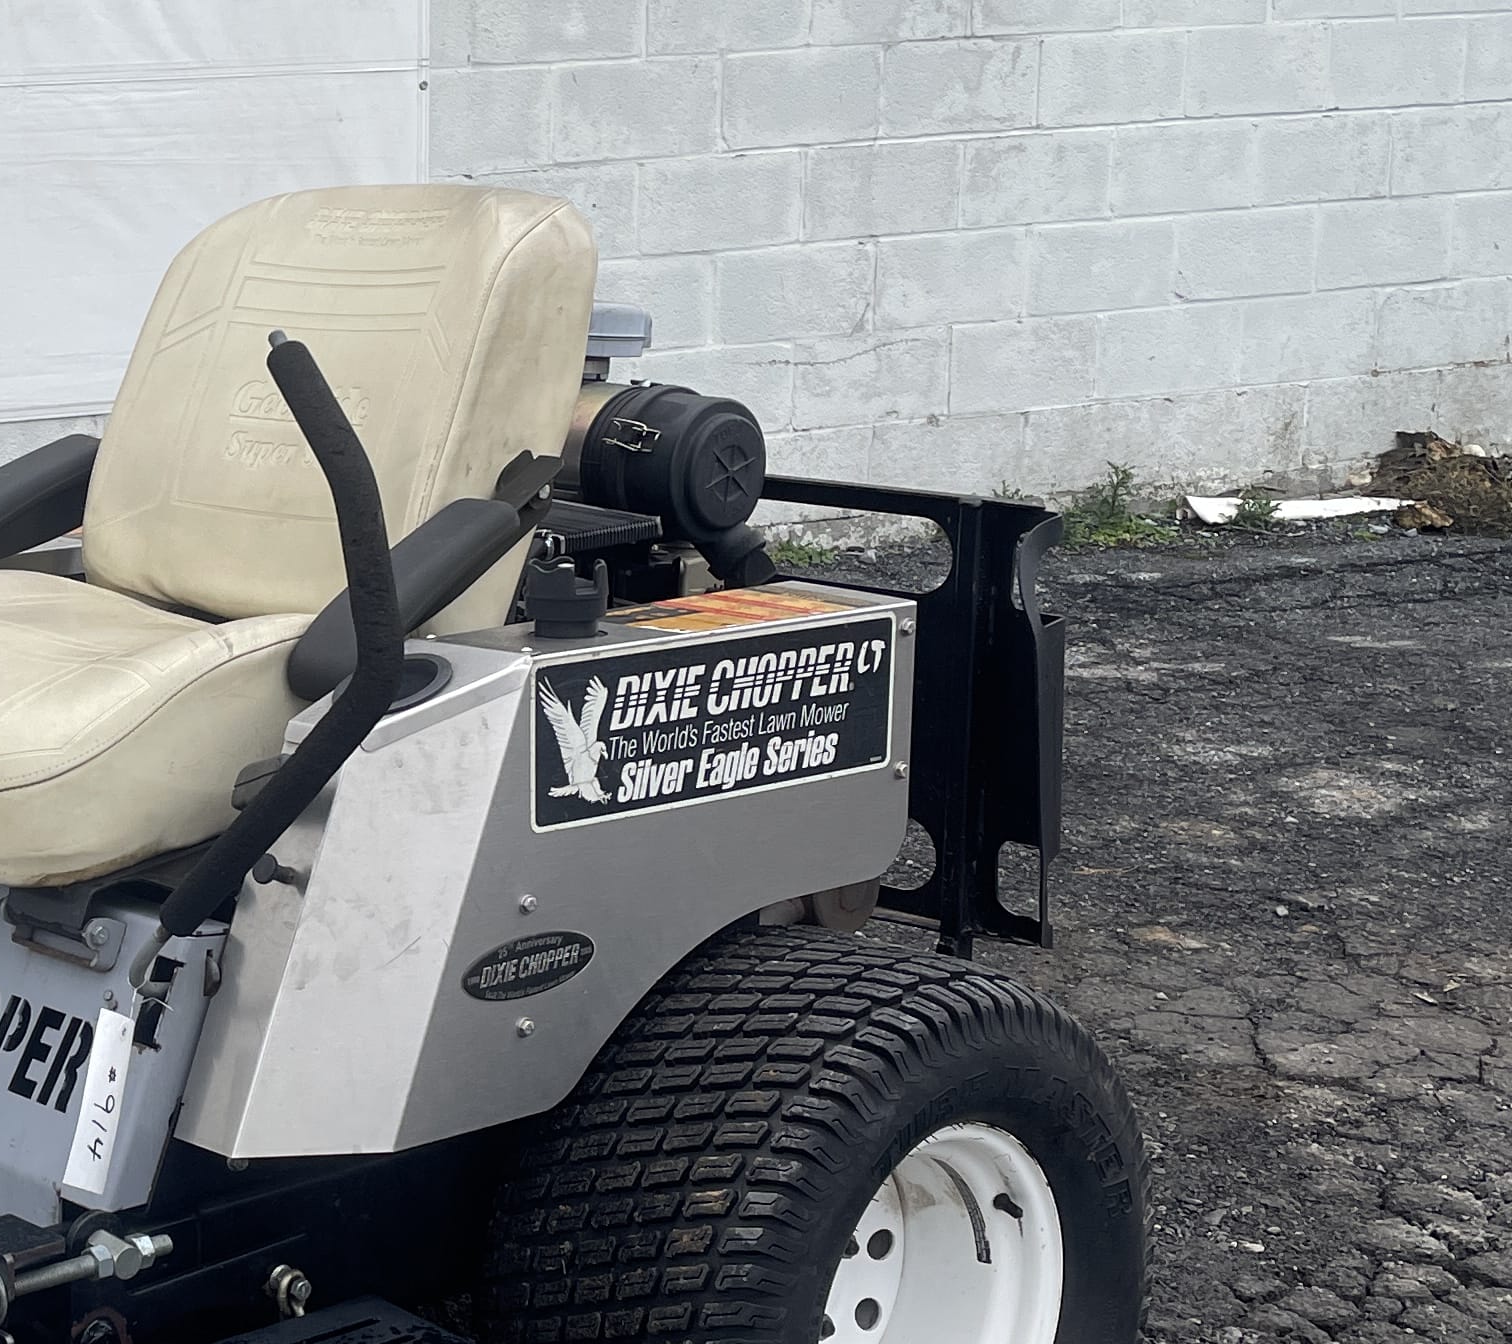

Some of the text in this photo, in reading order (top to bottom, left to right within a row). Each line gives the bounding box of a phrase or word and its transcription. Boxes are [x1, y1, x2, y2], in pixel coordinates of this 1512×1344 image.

[609, 664, 707, 732] DIXIE
[706, 641, 855, 716] CHOPPER
[609, 702, 850, 761] The World's Fastest Lawn Mower
[616, 729, 840, 803] Silver Eagle Series
[479, 959, 519, 990] DIXIE
[518, 943, 581, 979] CHOPPER
